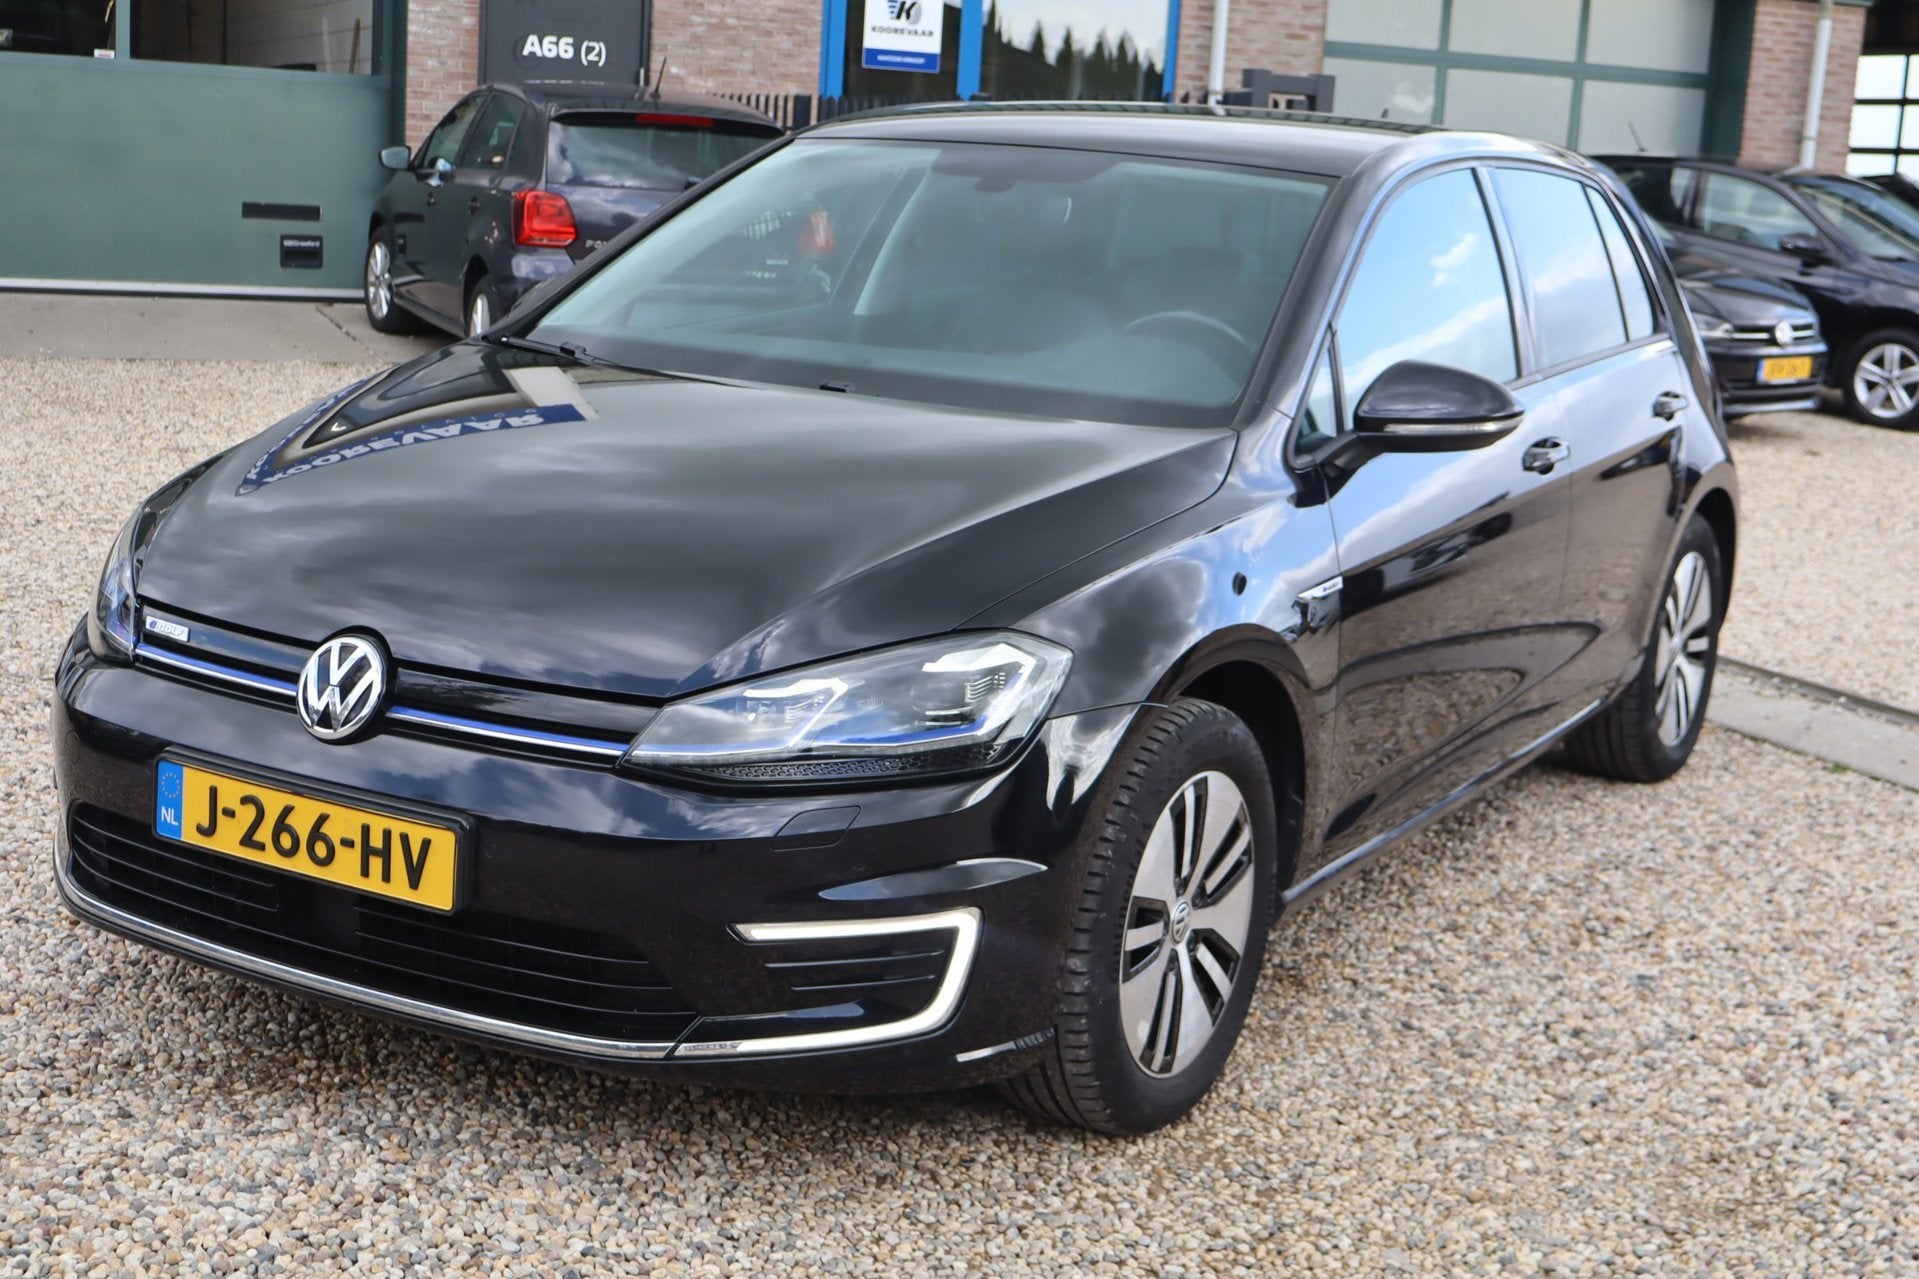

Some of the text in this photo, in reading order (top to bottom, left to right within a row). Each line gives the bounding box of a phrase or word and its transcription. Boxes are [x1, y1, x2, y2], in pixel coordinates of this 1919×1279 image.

[522, 34, 606, 67] A66 (2)
[160, 806, 179, 827] NL
[195, 785, 432, 891] J-266-HV
